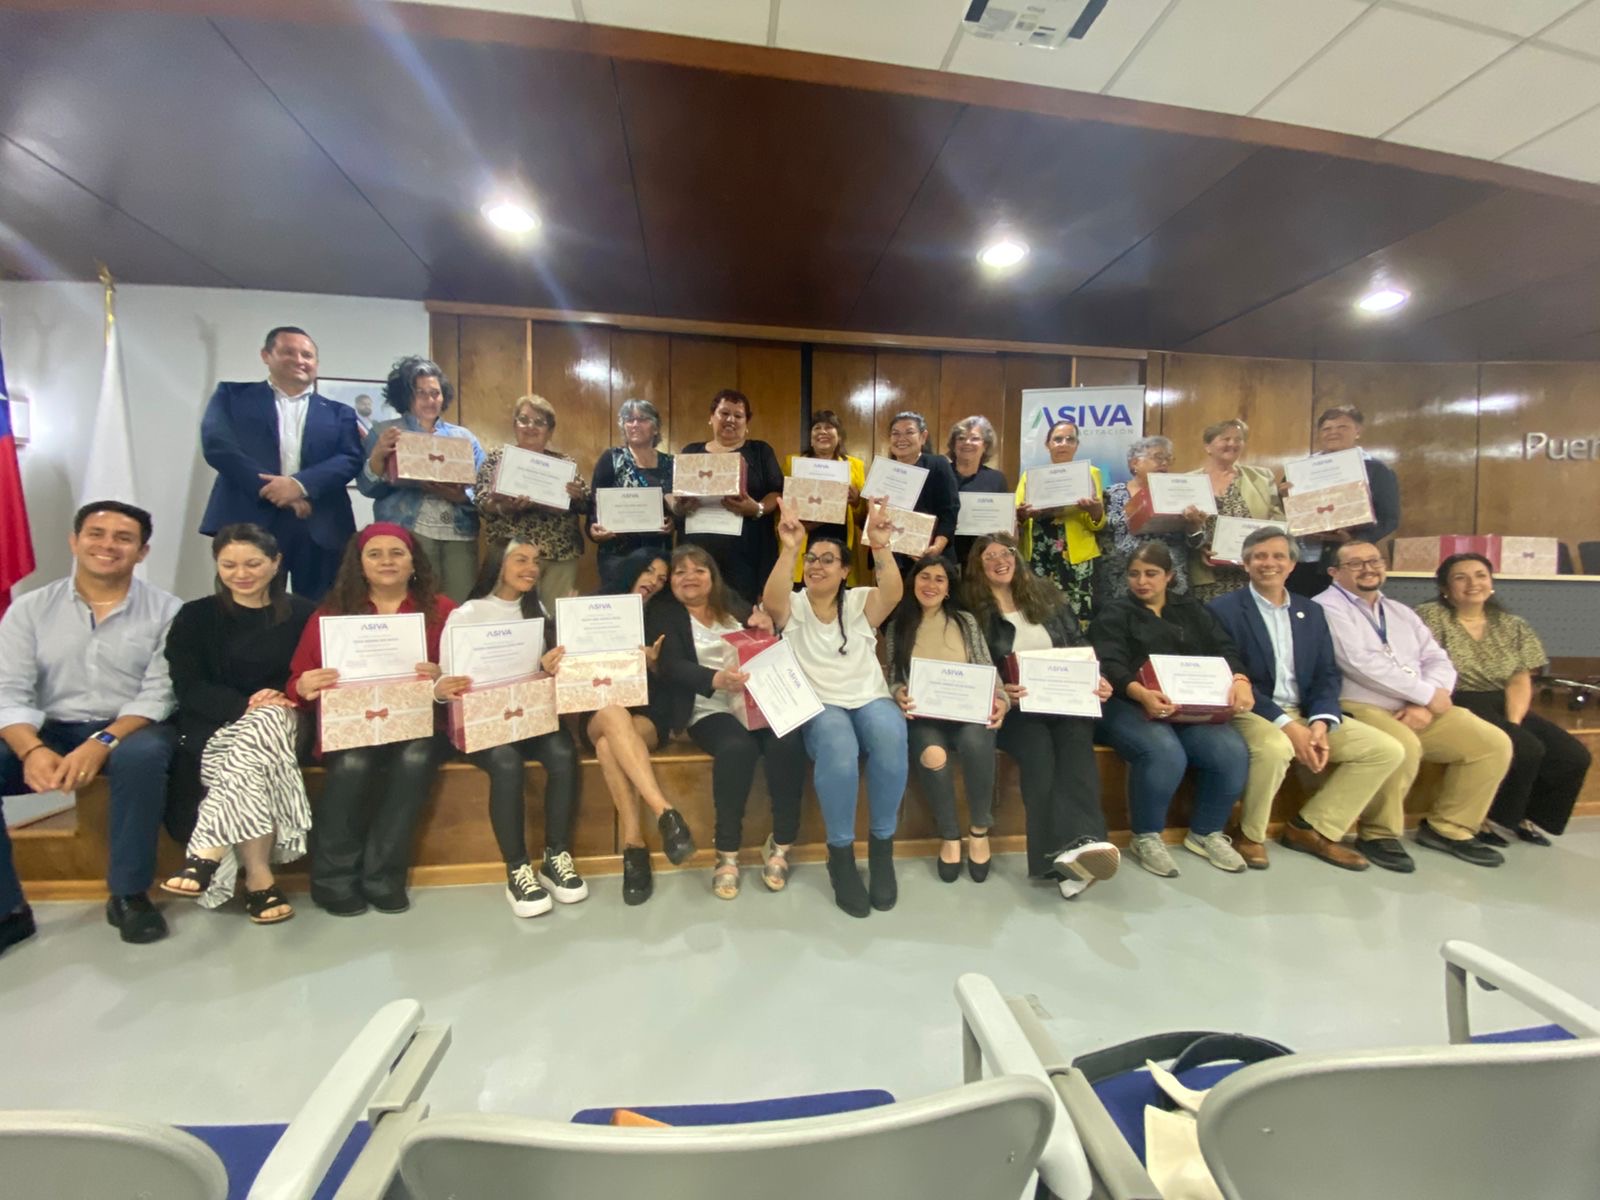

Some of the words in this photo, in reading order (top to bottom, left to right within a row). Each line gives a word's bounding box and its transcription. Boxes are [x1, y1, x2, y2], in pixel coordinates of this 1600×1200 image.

[1032, 403, 1133, 429] ASIVA
[588, 603, 612, 611] ASIVA
[361, 623, 388, 632] ASIVA
[486, 629, 512, 638] ASIVA
[941, 668, 964, 677] ASIVA
